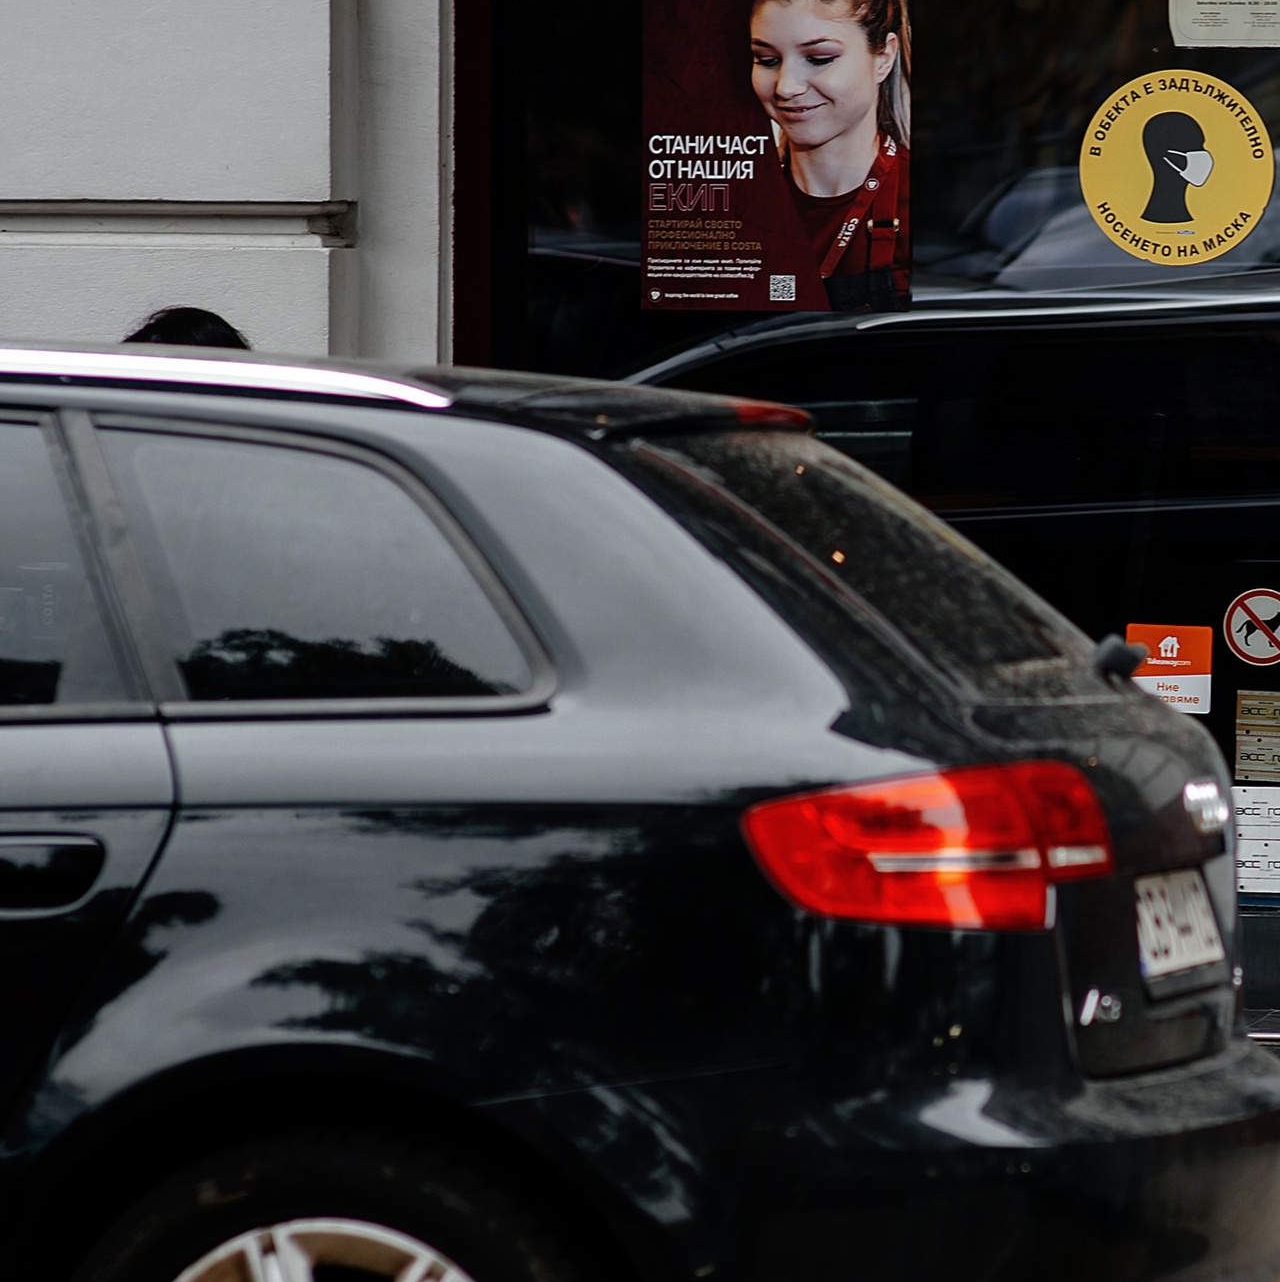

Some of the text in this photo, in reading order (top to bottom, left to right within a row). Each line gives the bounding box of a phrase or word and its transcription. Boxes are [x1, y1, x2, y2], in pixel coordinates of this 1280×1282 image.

[1089, 77, 1264, 160] В ОБЕКТА Е ЗАДЪЛЖИТЕЛНО
[648, 135, 769, 155] СТАНИ ЧАСТ
[648, 159, 754, 179] ОТ НАШИЯ
[649, 183, 729, 211] ЕКИП
[648, 218, 742, 229] СТАРТИРАЙ СВОЕТО
[838, 218, 859, 247] COSTA
[1097, 201, 1252, 257] НОСЕНЕТО НА МАСКА
[648, 230, 736, 239] ПРОФЕСИОНАЛНО
[648, 241, 762, 250] ПРИКЛЮЧЕНИЕ В COSTA
[1157, 683, 1180, 692] Ние
